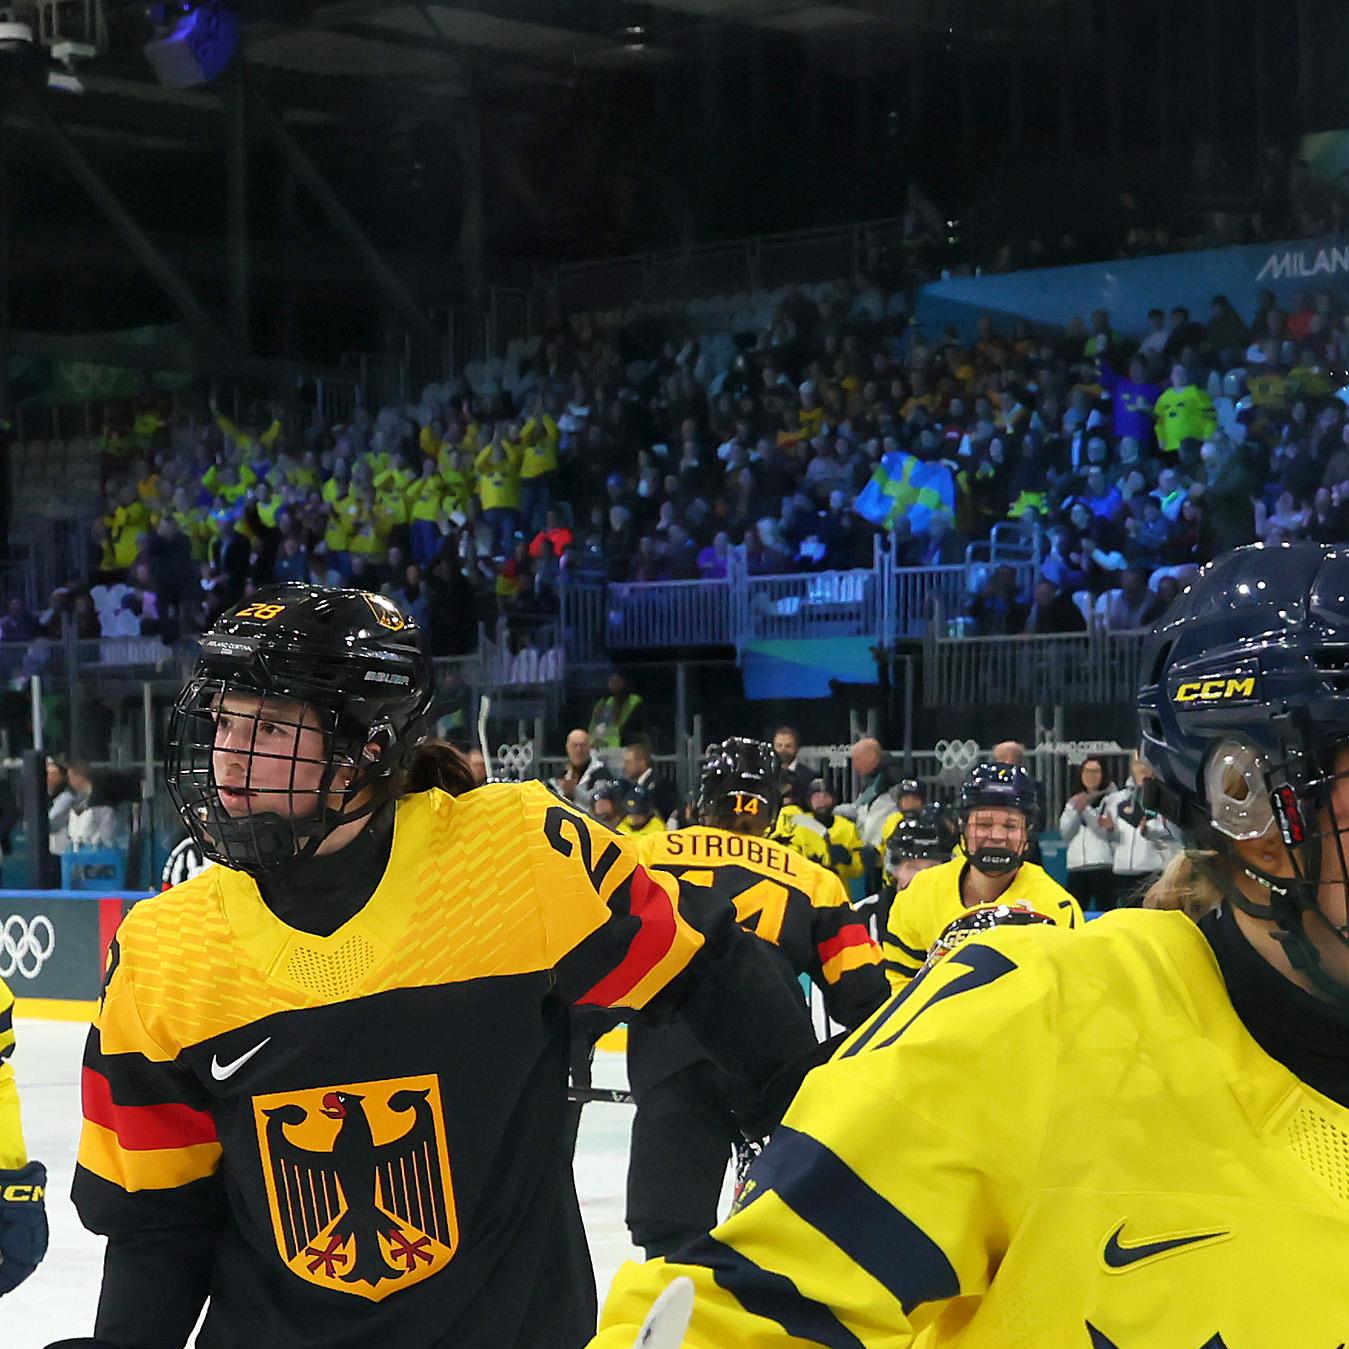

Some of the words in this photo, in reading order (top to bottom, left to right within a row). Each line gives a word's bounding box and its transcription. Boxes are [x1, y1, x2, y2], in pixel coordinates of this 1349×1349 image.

[235, 602, 286, 620] 28
[1176, 677, 1256, 702] CCM
[732, 794, 760, 815] 14
[666, 833, 797, 877] STROBEL
